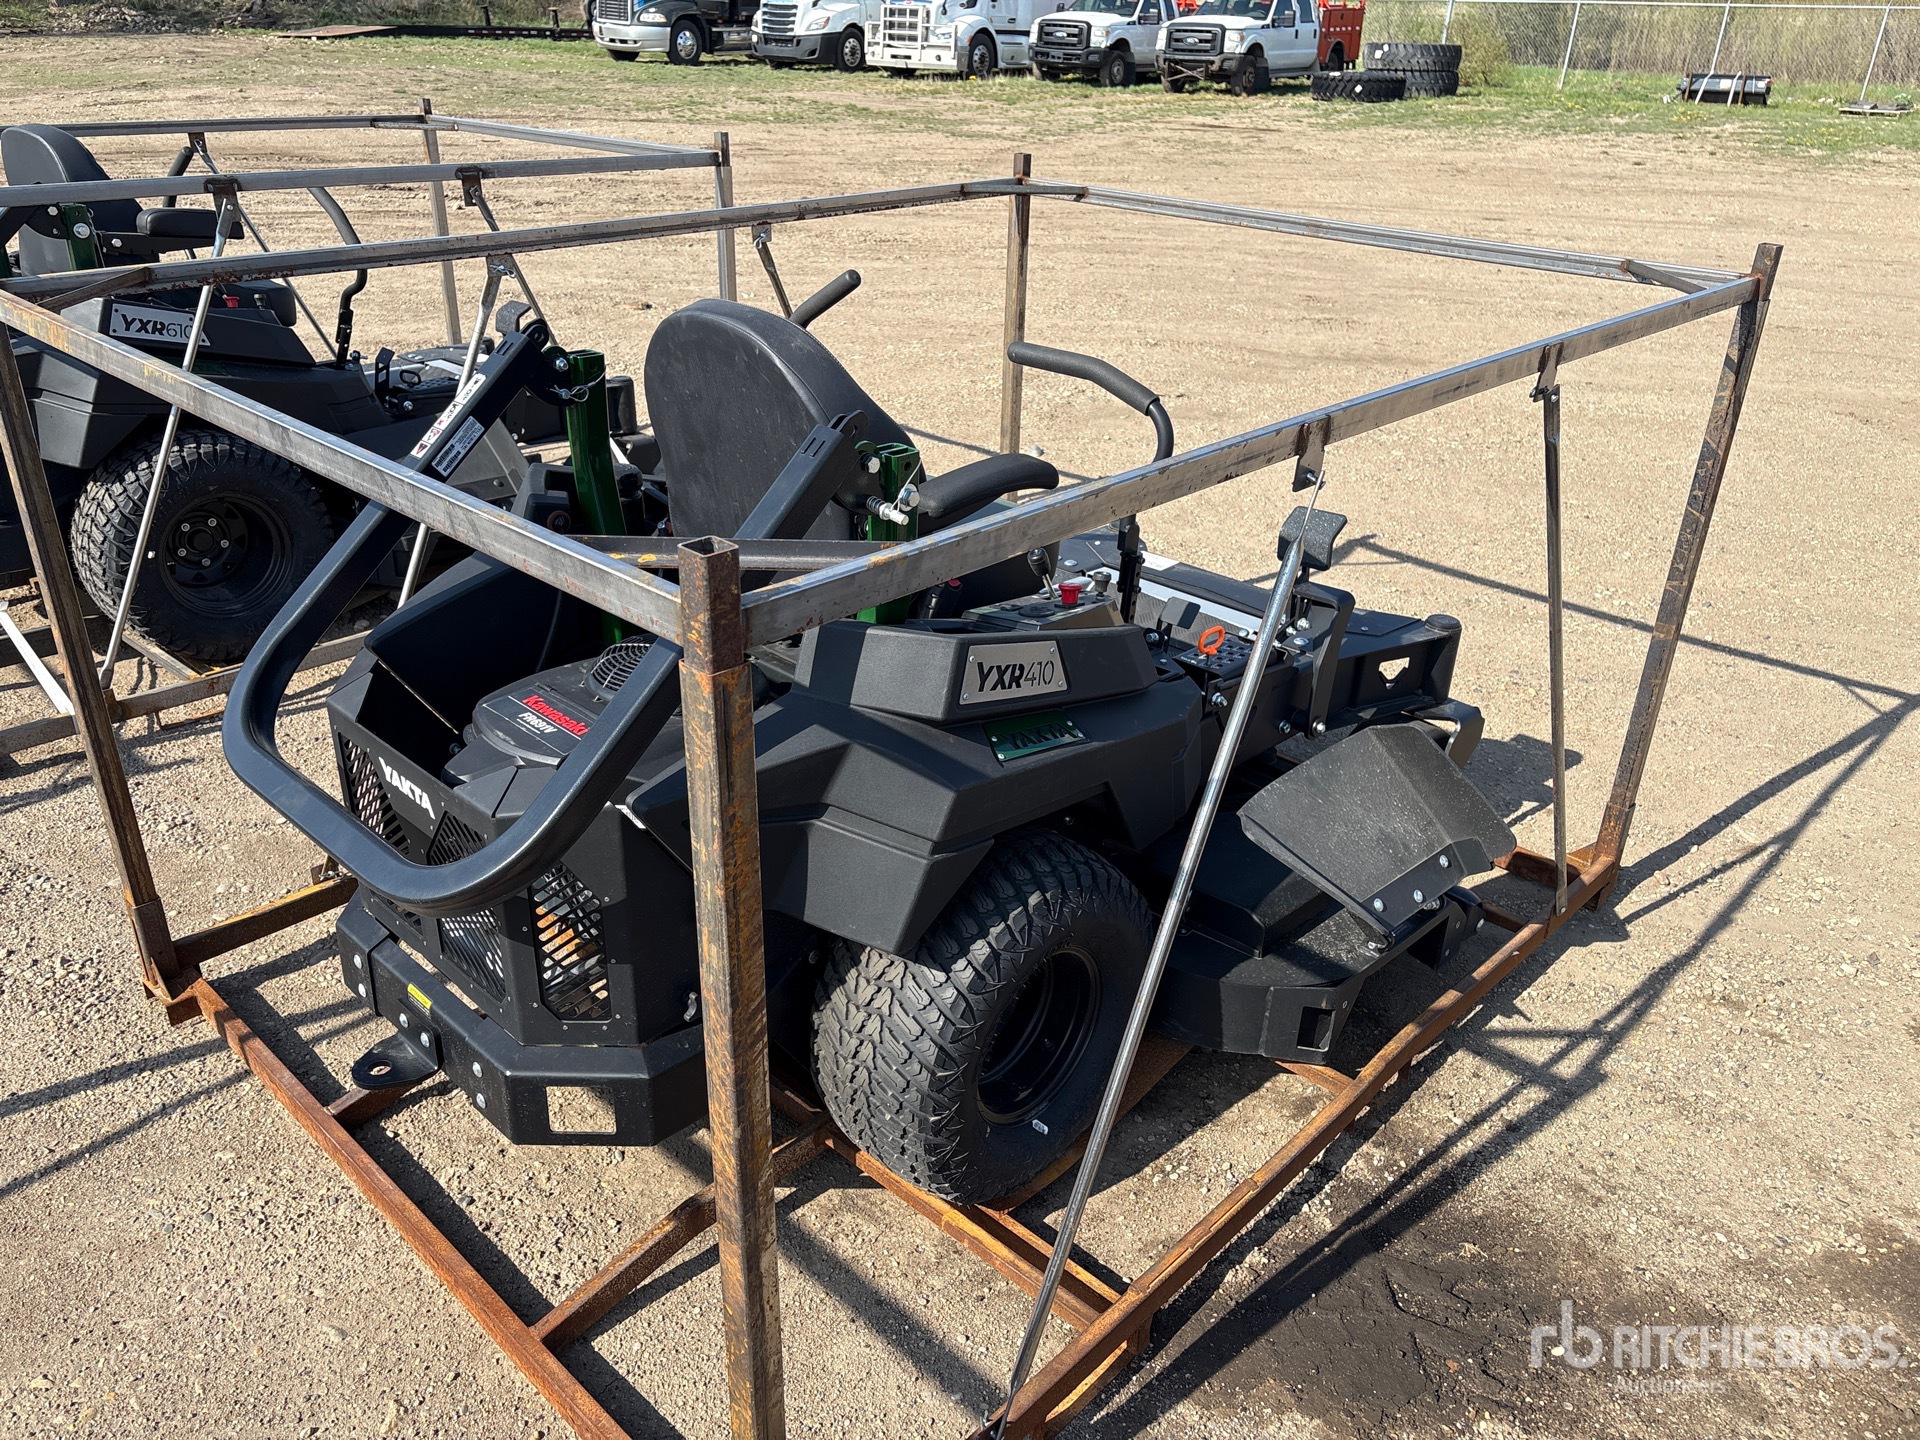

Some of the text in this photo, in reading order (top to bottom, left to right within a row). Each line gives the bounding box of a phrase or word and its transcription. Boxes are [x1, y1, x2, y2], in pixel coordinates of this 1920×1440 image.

[977, 660, 1055, 692] YXR410
[518, 711, 558, 734] FR691V
[522, 694, 590, 736] Kawasaki
[378, 756, 436, 820] YAKTA
